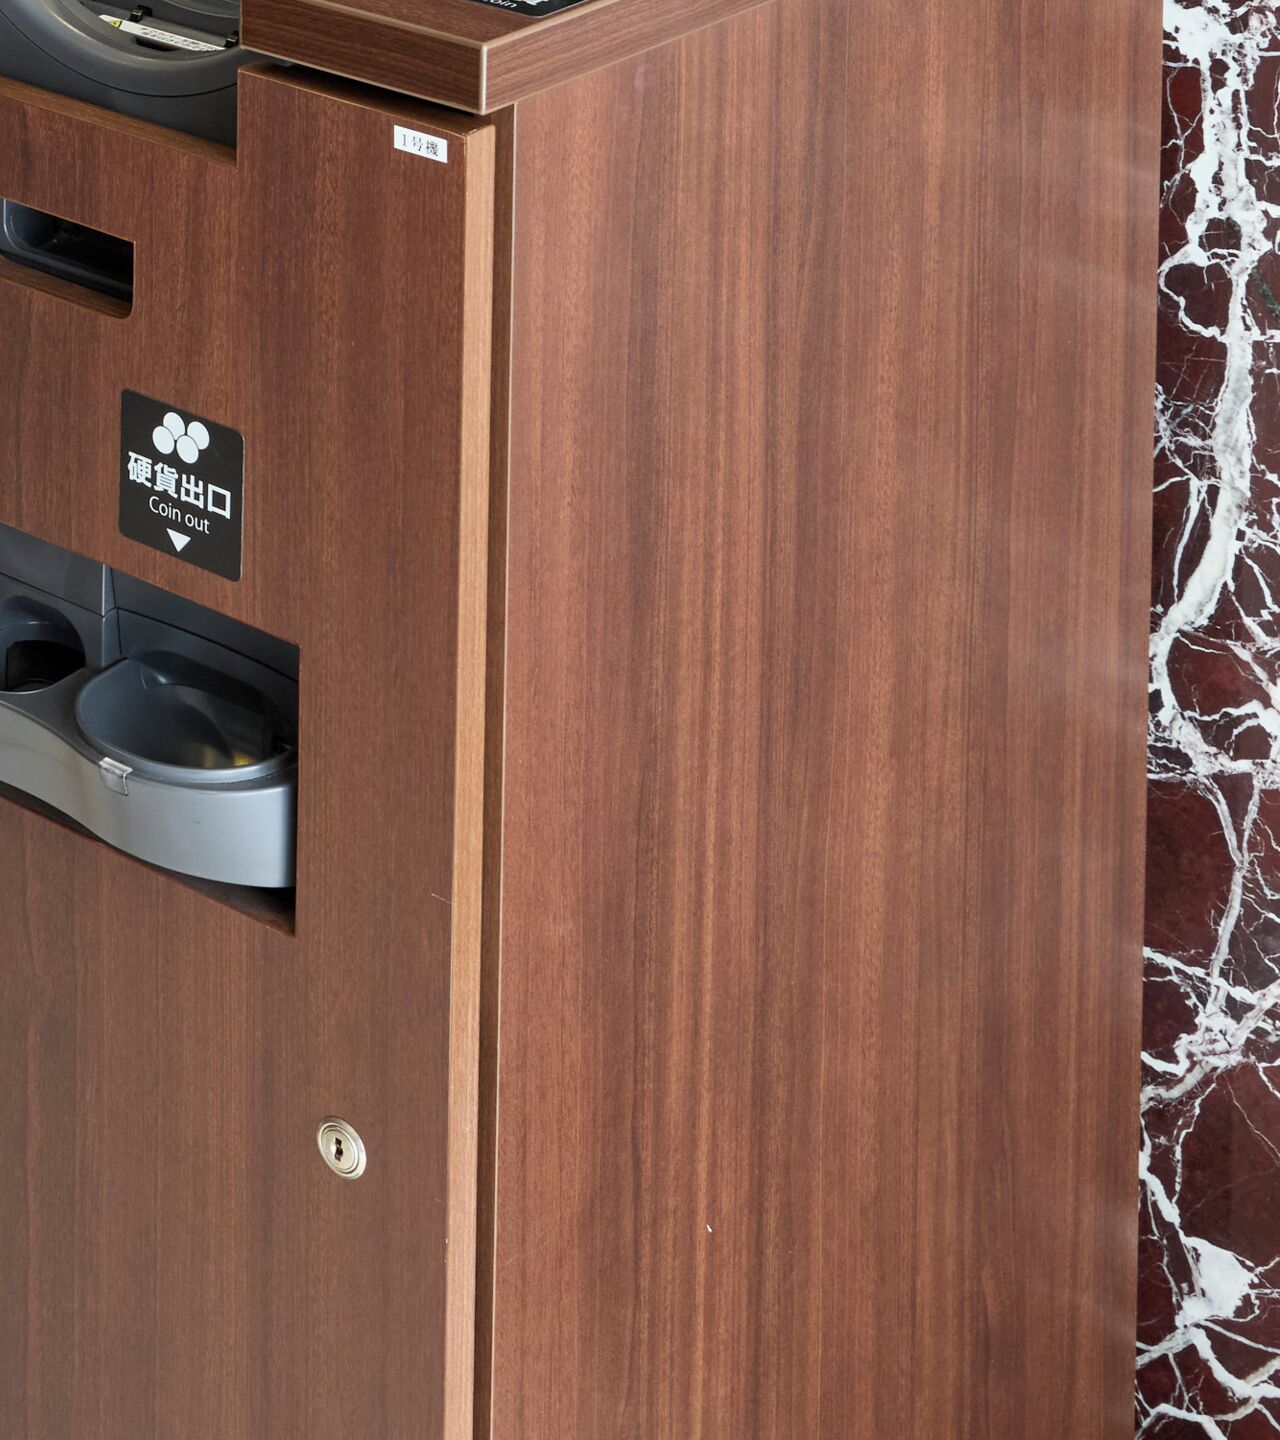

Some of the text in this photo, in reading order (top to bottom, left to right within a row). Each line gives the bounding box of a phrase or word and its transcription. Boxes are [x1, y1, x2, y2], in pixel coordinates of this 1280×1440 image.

[402, 134, 439, 157] 1号機
[127, 450, 232, 520] 硬貨出口
[148, 495, 211, 535] Coin out
